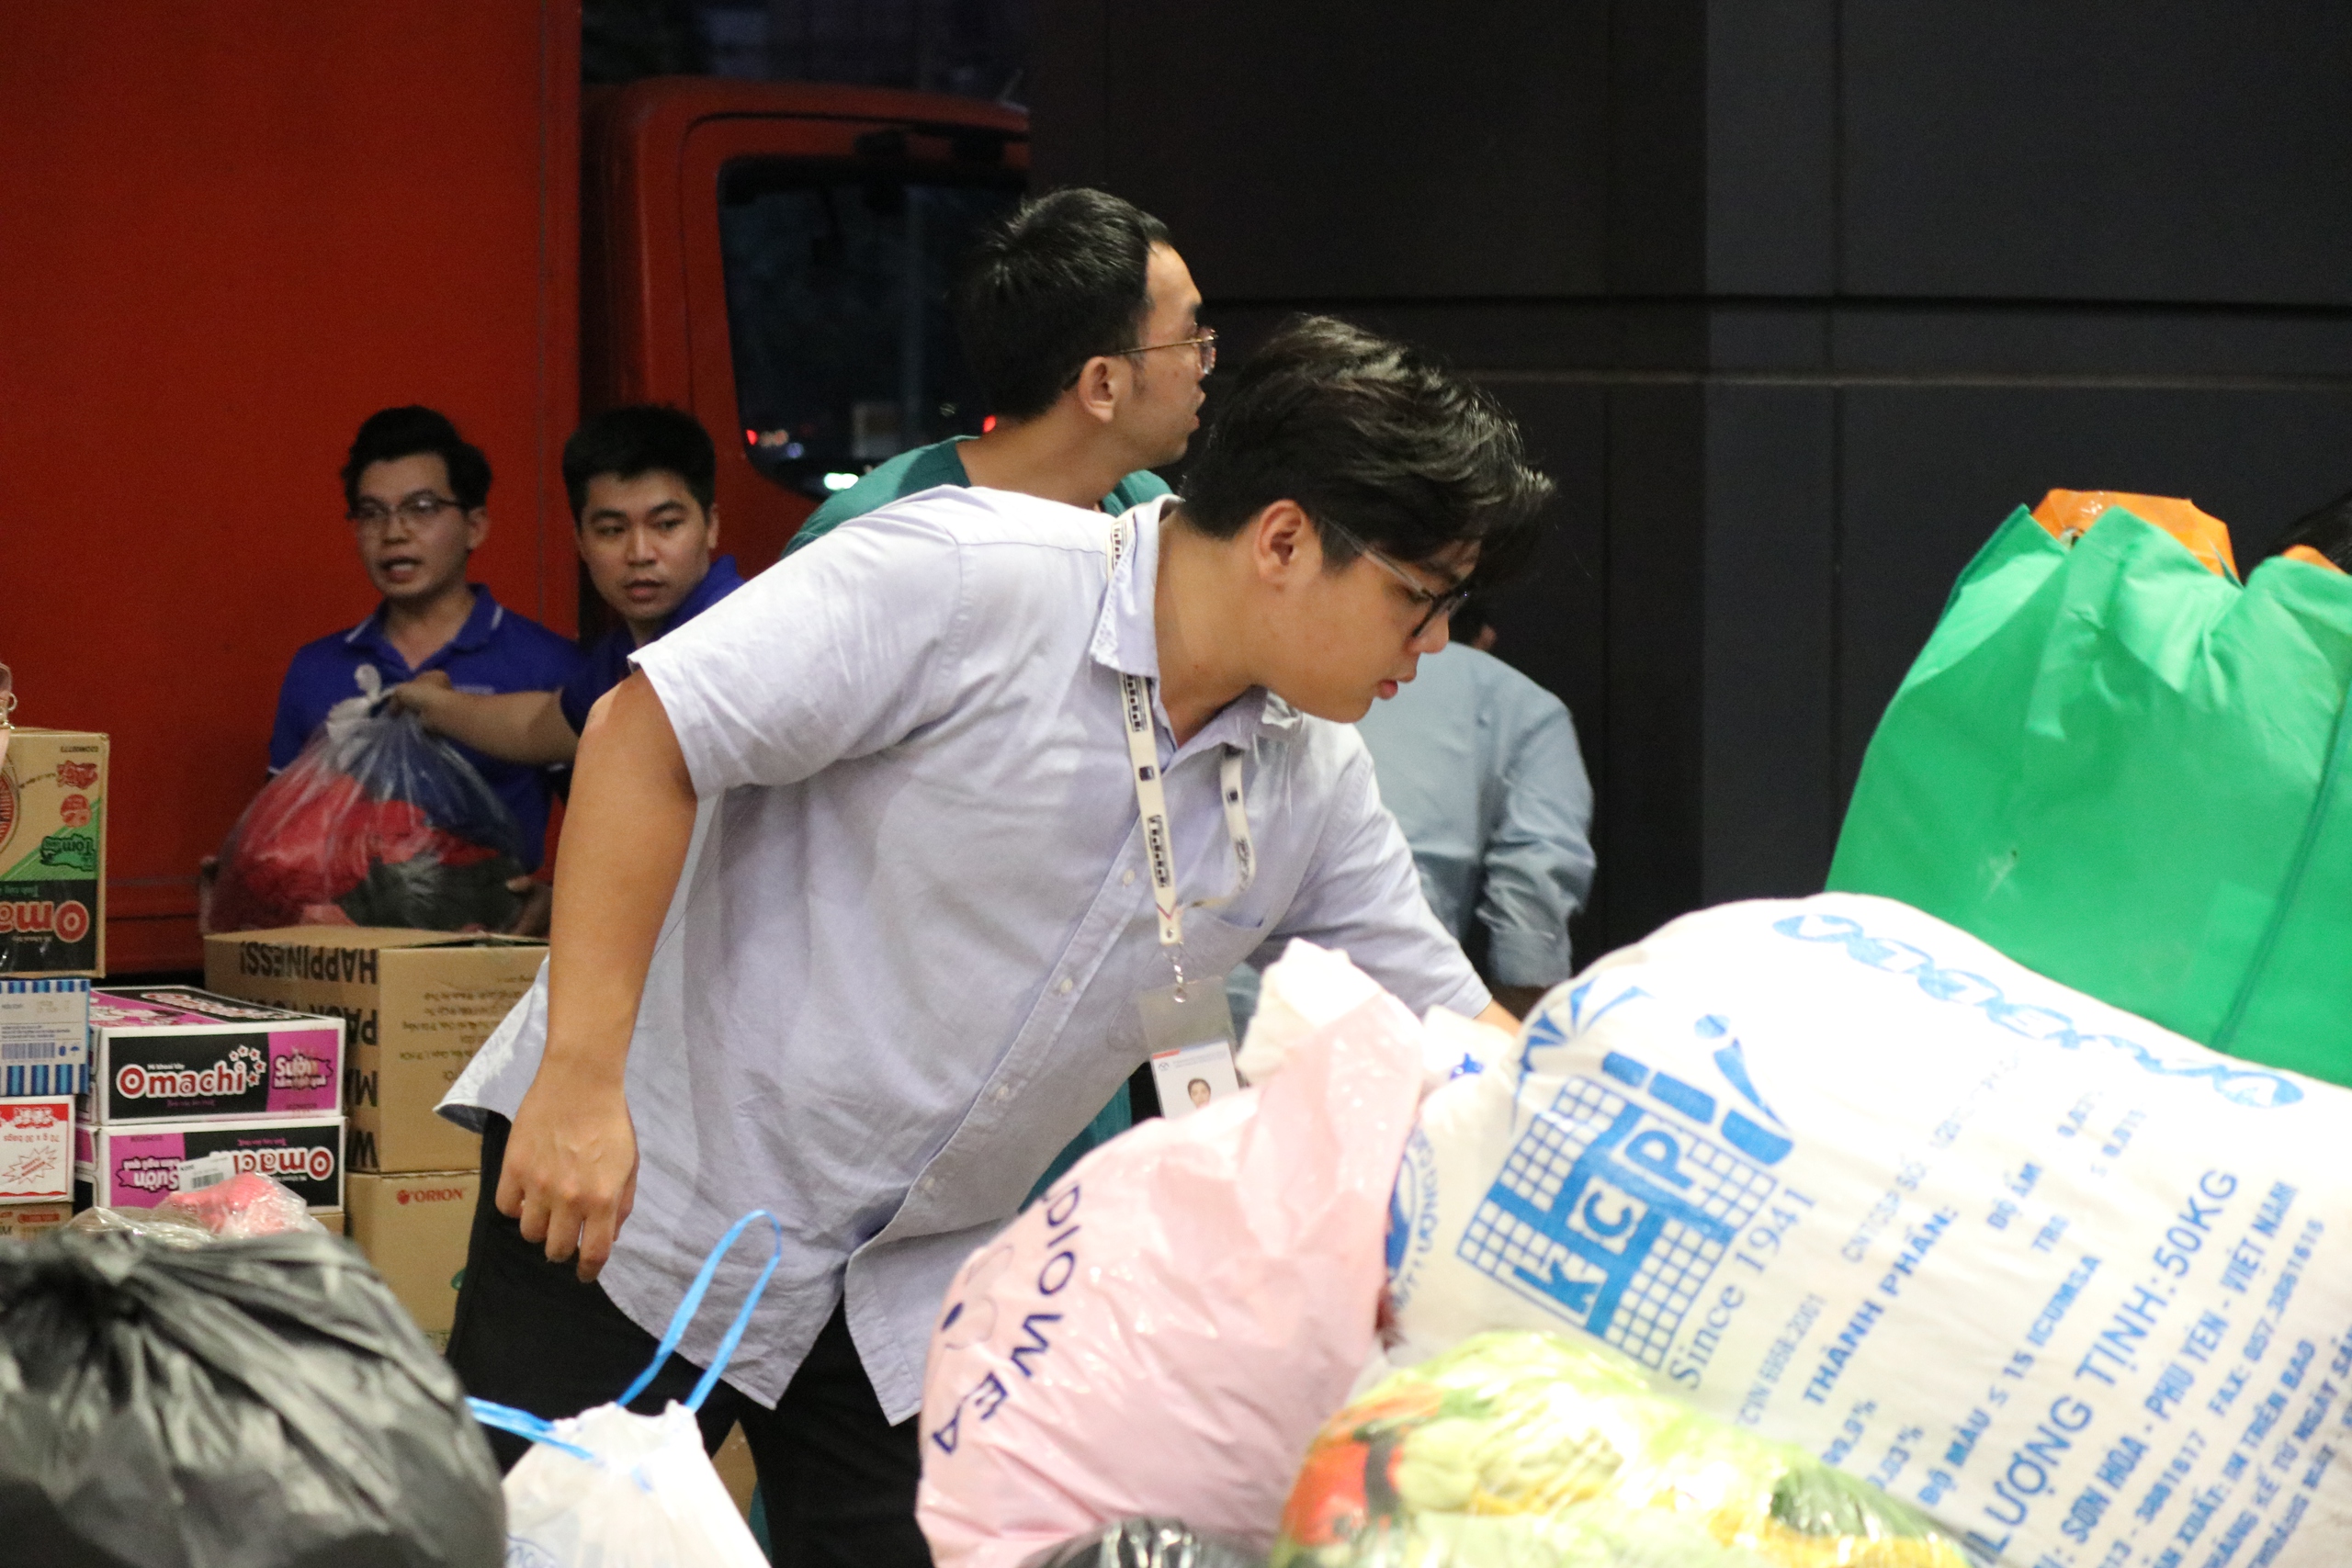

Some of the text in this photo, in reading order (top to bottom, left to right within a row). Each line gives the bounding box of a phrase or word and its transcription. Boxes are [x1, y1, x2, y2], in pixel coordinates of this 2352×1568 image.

[240, 941, 378, 981] HAPPINESS!
[117, 1059, 246, 1099] Omachi
[4, 1134, 23, 1143] bags
[413, 1189, 464, 1202] ORION
[2251, 1181, 2296, 1238] NAM
[1667, 1188, 1816, 1392] Since 1941
[1804, 1301, 1884, 1404] THÀNH
[2002, 1351, 2036, 1380] 15
[2279, 1339, 2316, 1392] BAO
[1966, 1395, 2095, 1556] LƯỢNG
